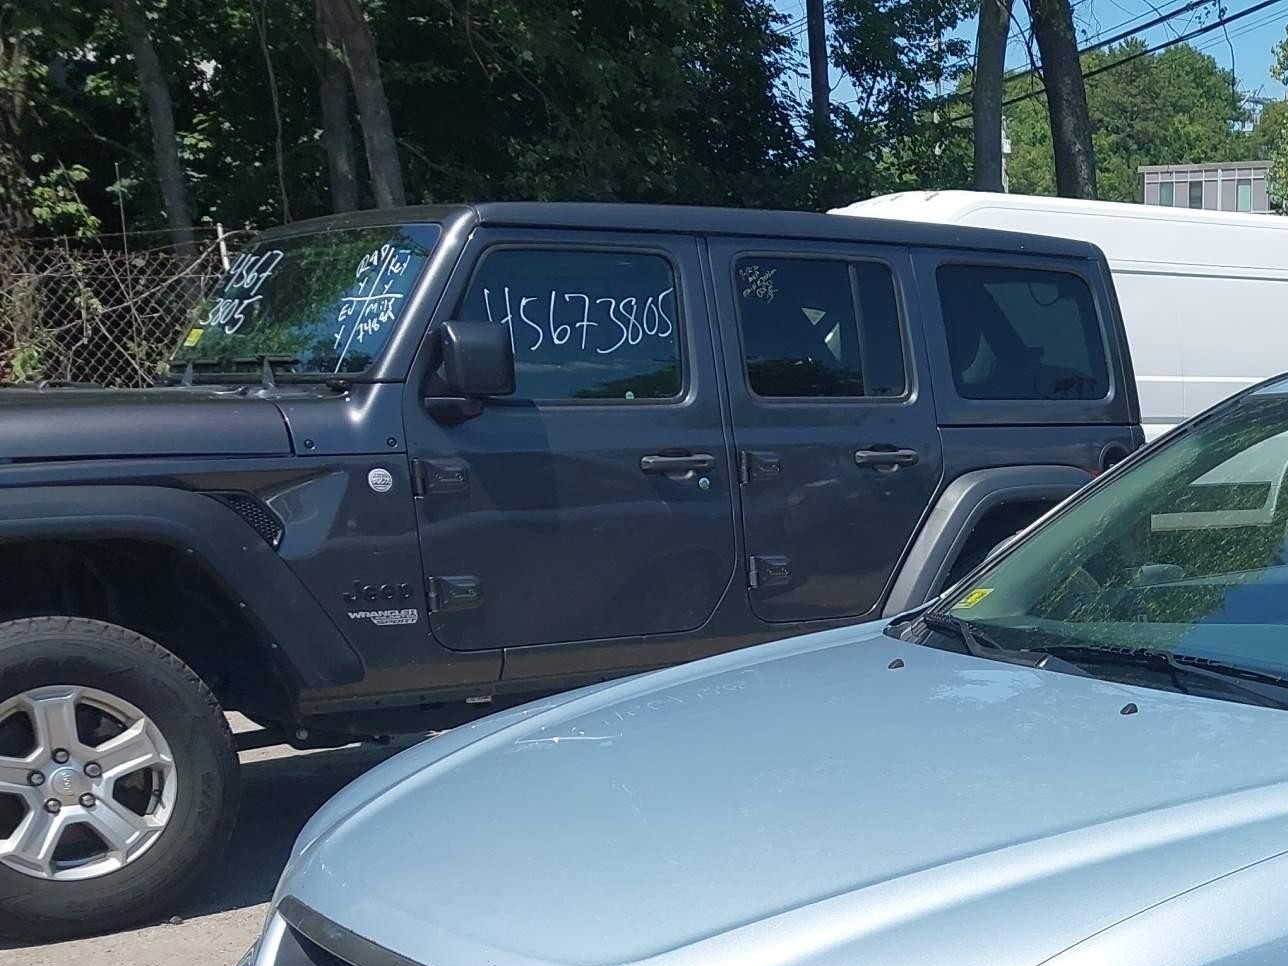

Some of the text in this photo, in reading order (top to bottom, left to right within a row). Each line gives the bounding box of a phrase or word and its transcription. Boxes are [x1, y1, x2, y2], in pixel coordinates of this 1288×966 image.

[223, 250, 284, 296] 4567
[199, 295, 263, 334] 3805
[484, 287, 674, 355] 45673805
[347, 608, 418, 619] WRANGLER
